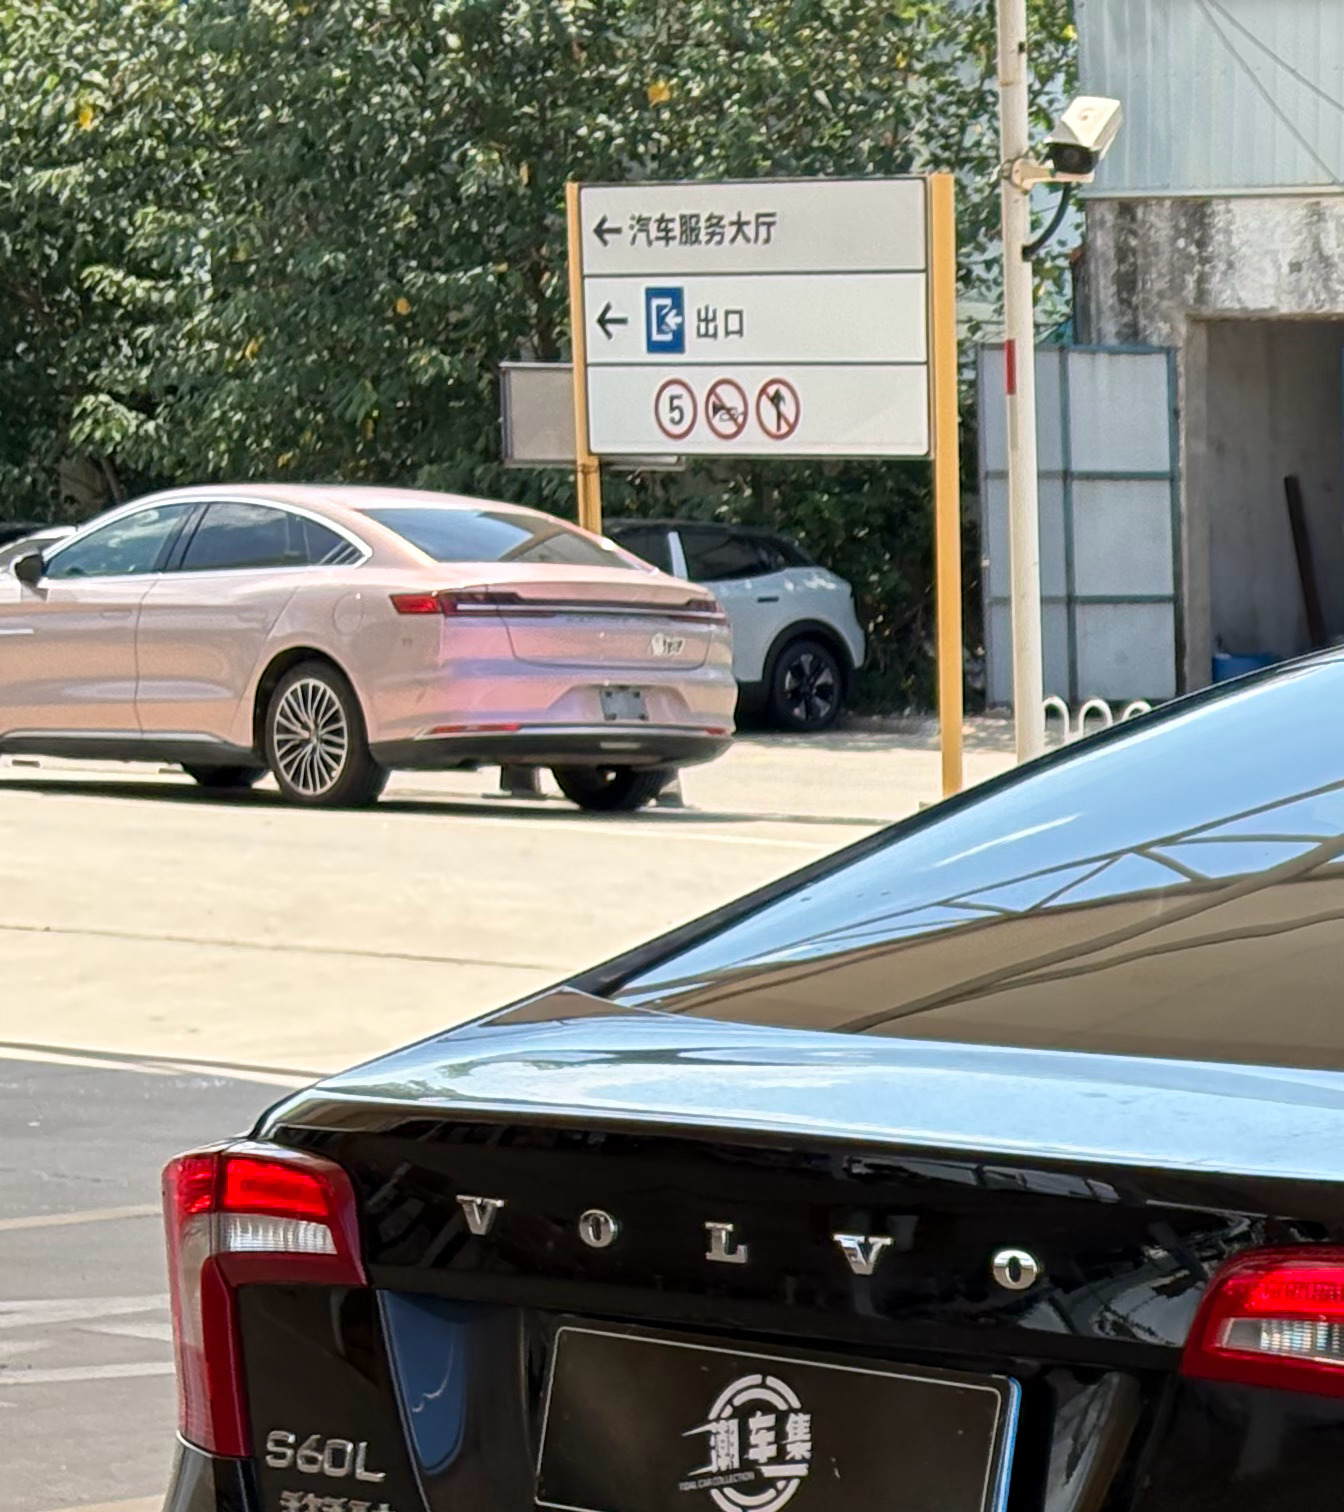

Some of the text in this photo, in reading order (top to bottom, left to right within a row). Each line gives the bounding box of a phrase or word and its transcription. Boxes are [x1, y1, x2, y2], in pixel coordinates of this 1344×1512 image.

[629, 211, 778, 248] 汽车服务大厅
[696, 303, 745, 340] 出口
[668, 394, 685, 427] 5
[456, 1195, 1039, 1290] VOLVO
[265, 1430, 387, 1483] S60L
